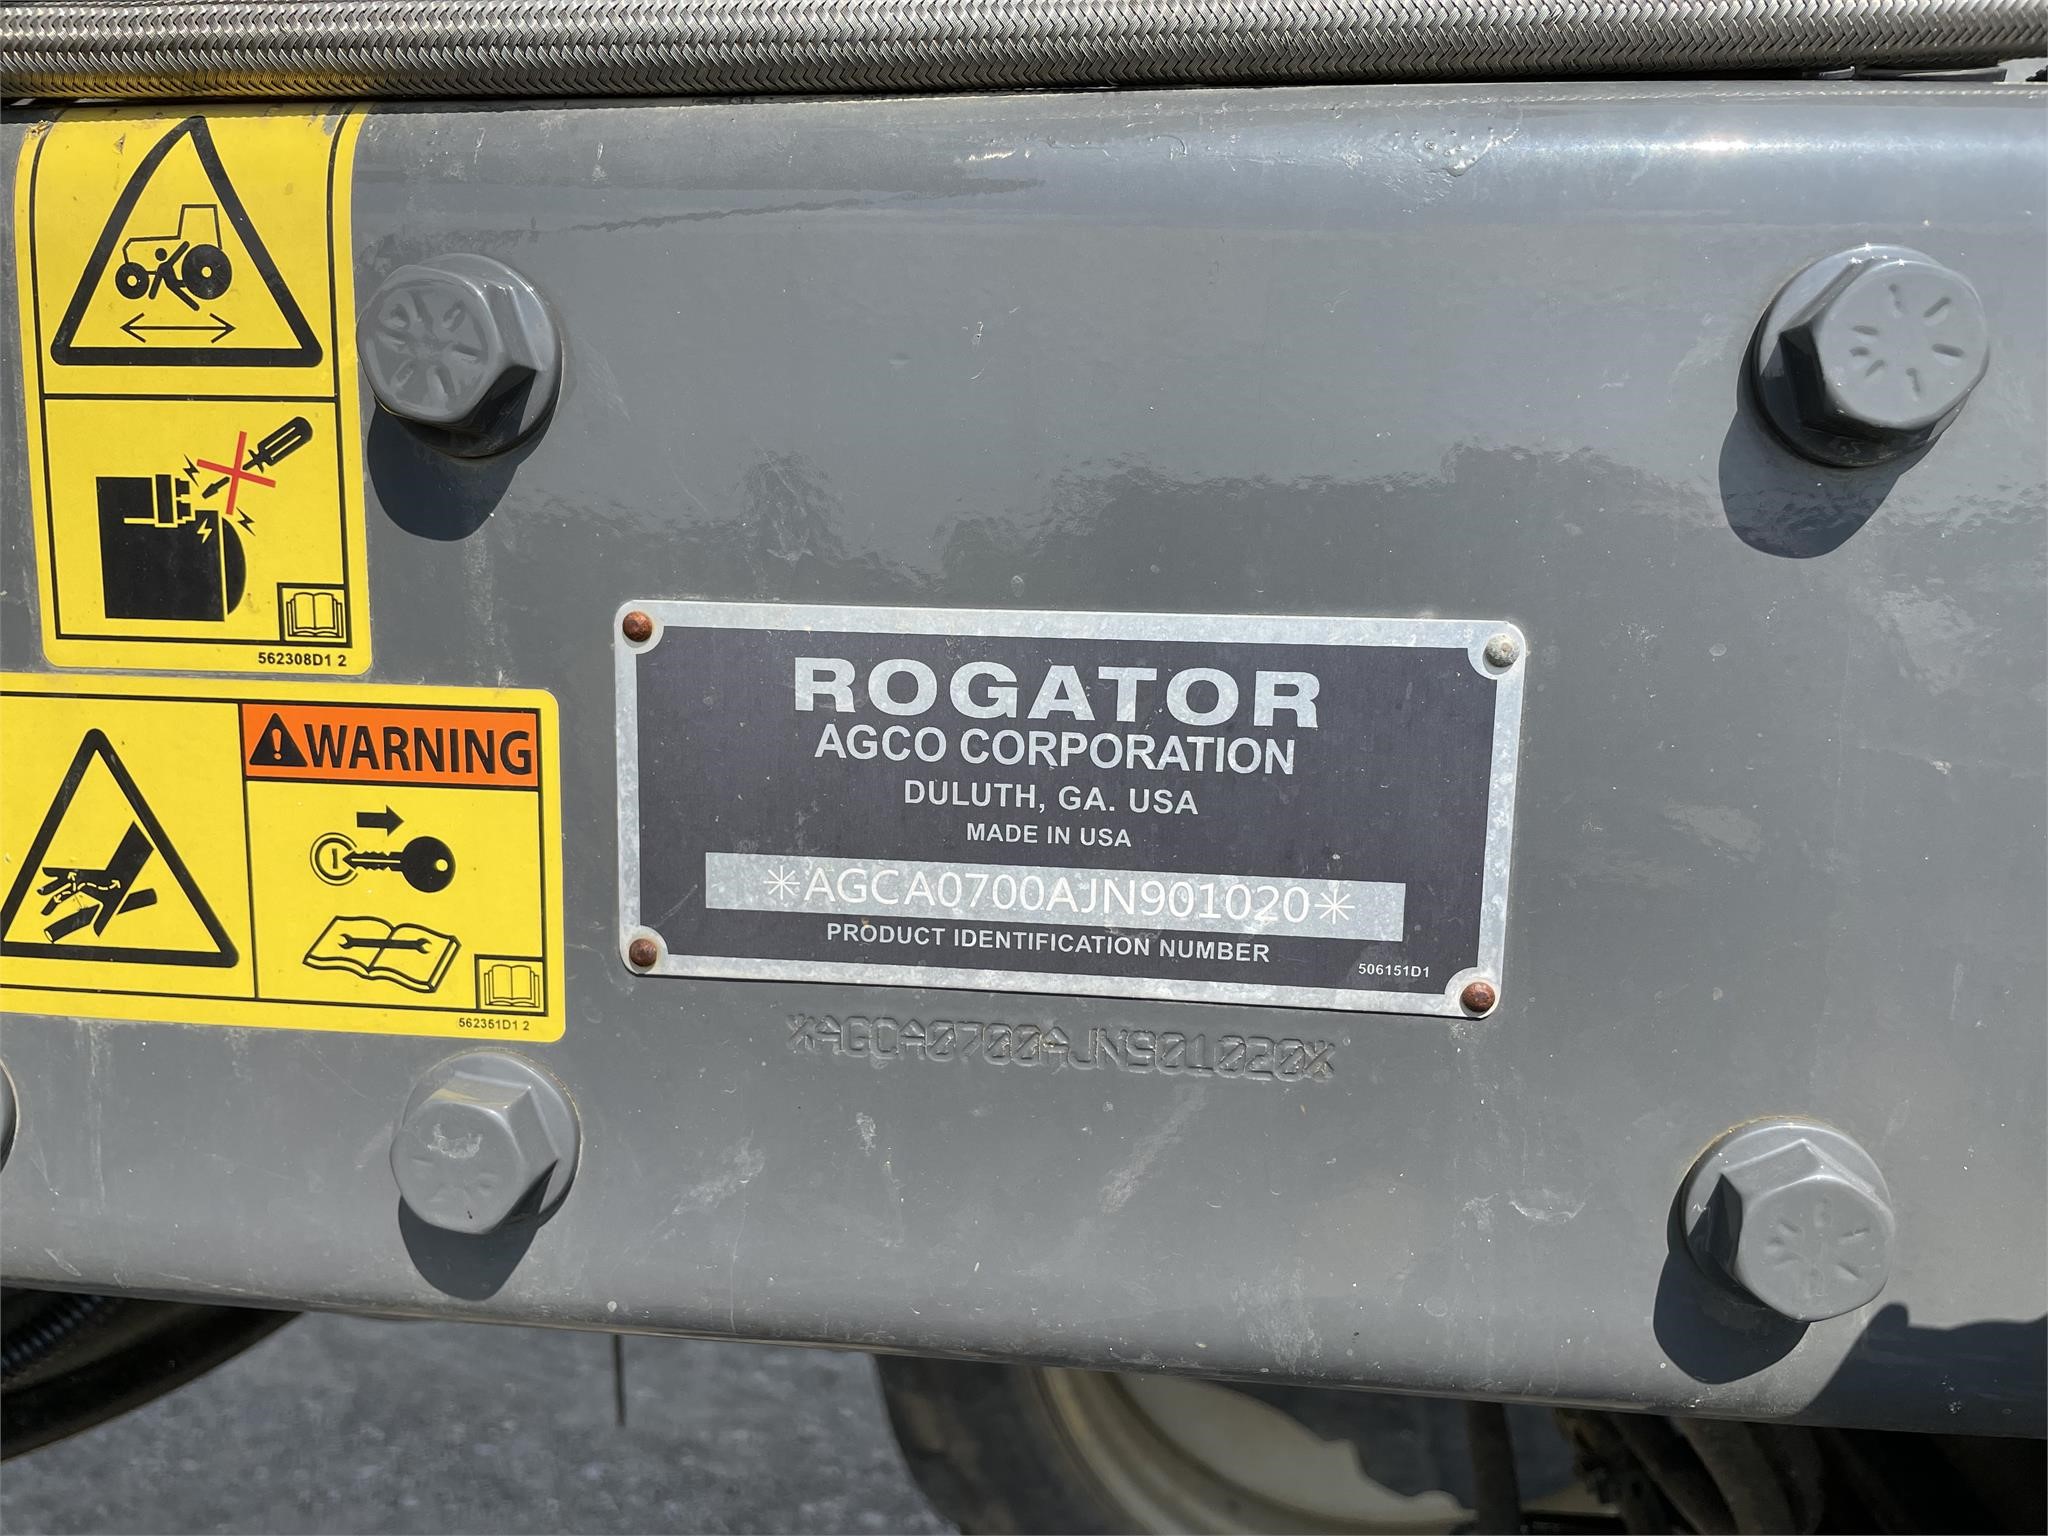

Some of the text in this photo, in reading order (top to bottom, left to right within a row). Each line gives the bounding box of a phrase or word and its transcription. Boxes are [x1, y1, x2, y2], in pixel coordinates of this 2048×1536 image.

[258, 652, 347, 667] 562308D1 2
[794, 657, 1320, 728] ROGATOR
[304, 723, 532, 775] WARNING
[814, 724, 1295, 775] AGCO CORPORATION
[905, 780, 1199, 815] DULUTH, GA. USA
[967, 822, 1132, 848] MADE IN USA
[827, 923, 1270, 963] PRODUCT IDENTIFICATION NUMBER
[1358, 963, 1429, 978] 506151D1
[458, 1017, 530, 1031] 562351D1 2
